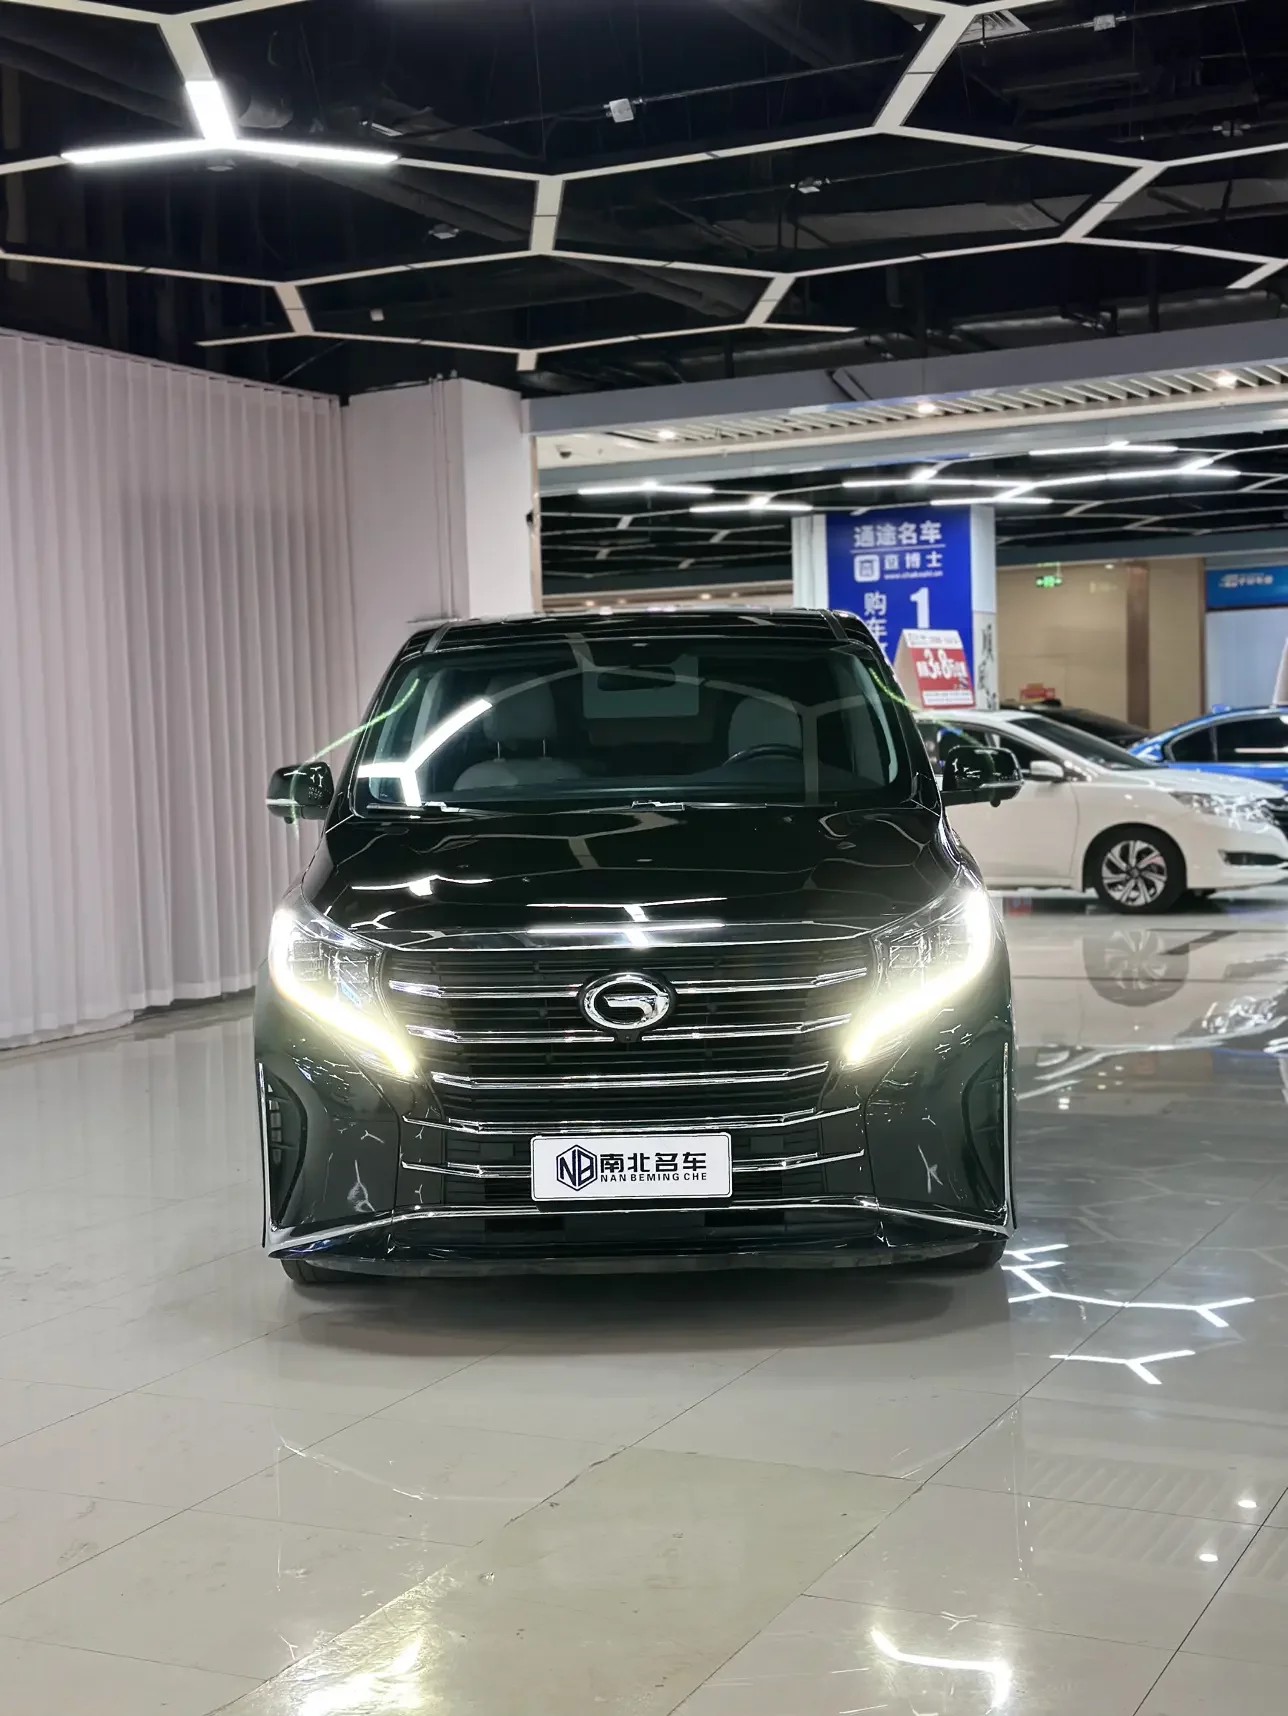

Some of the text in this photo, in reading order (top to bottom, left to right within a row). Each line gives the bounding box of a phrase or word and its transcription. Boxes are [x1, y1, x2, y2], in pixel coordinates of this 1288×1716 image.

[853, 520, 943, 548] 通途名车
[909, 586, 930, 629] 1
[863, 590, 888, 654] 购车
[600, 1152, 707, 1173] 南北名车
[600, 1172, 707, 1183] NAN BEMING CHE
